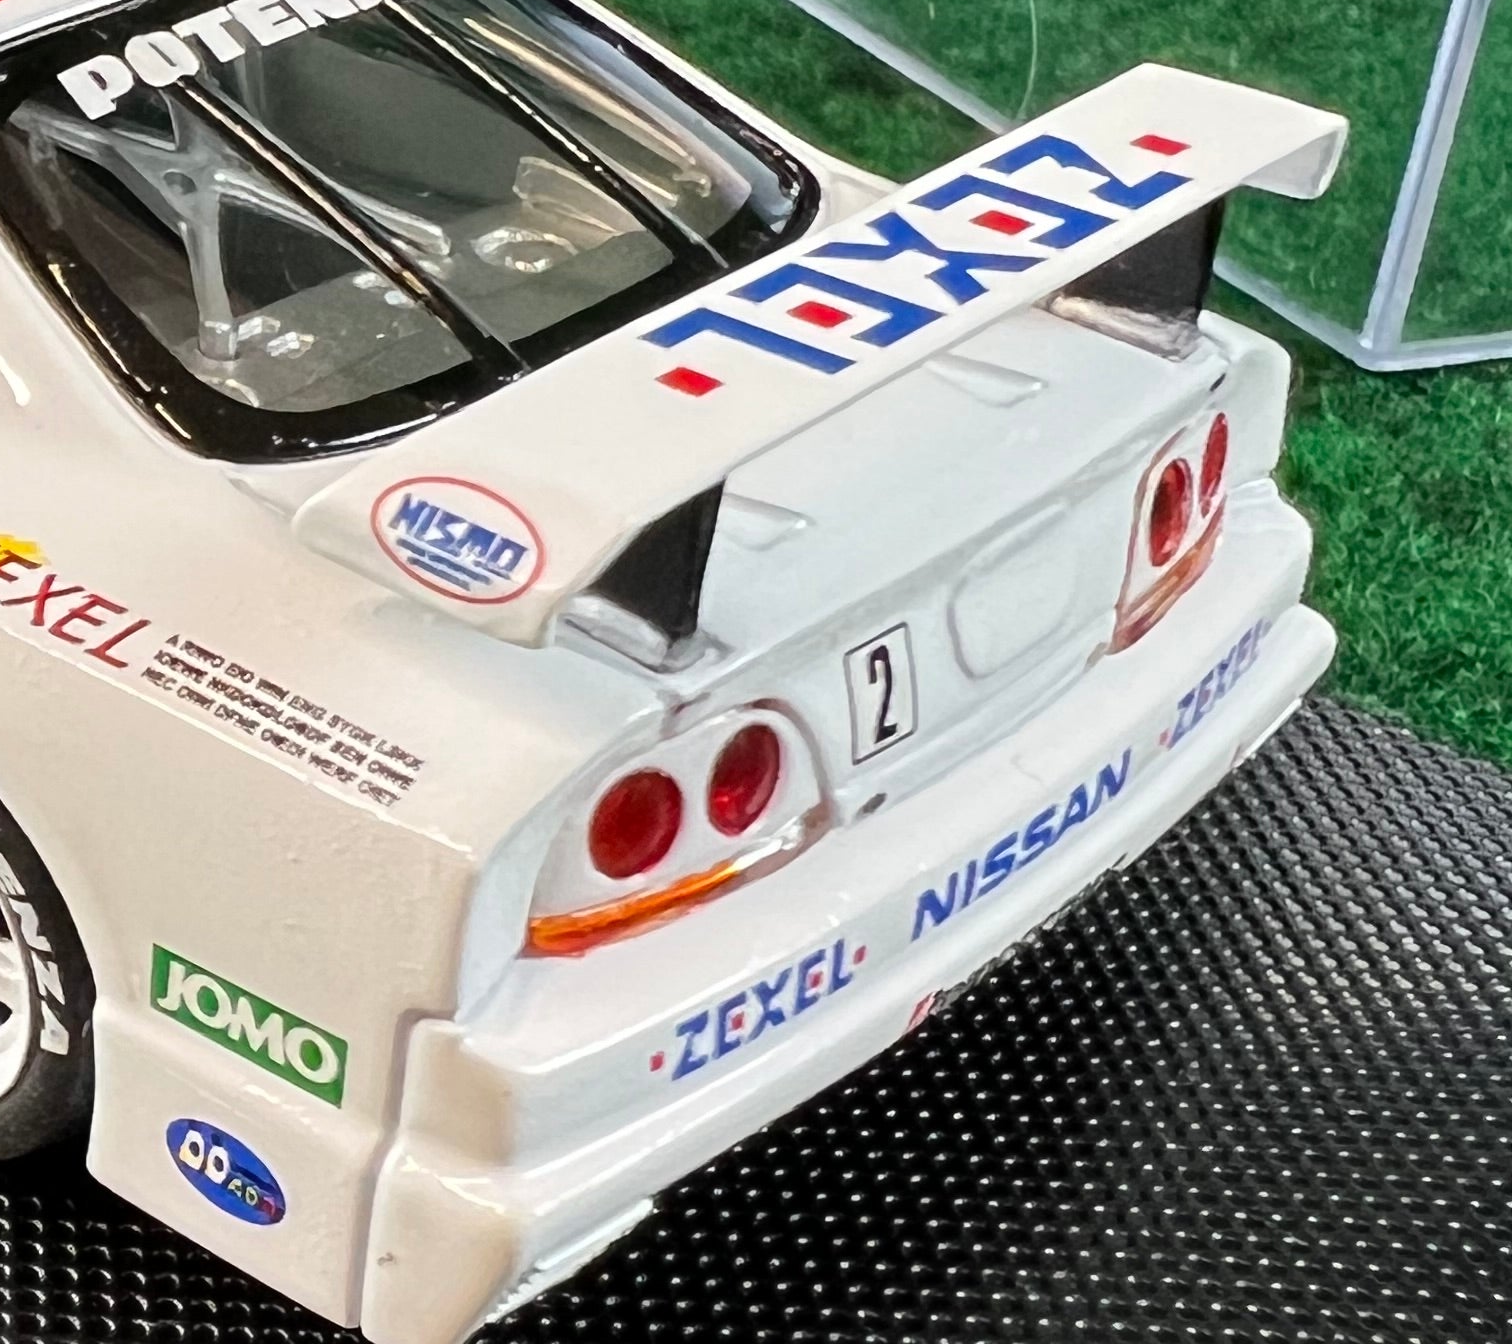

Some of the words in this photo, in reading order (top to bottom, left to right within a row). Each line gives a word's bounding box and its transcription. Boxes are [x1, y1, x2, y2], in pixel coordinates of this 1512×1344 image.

[638, 133, 1194, 374] ZEXEL
[868, 644, 898, 743] 2
[671, 939, 853, 1080] ZEXEL
[911, 747, 1132, 942] NISSAN
[157, 960, 339, 1084] JOMO
